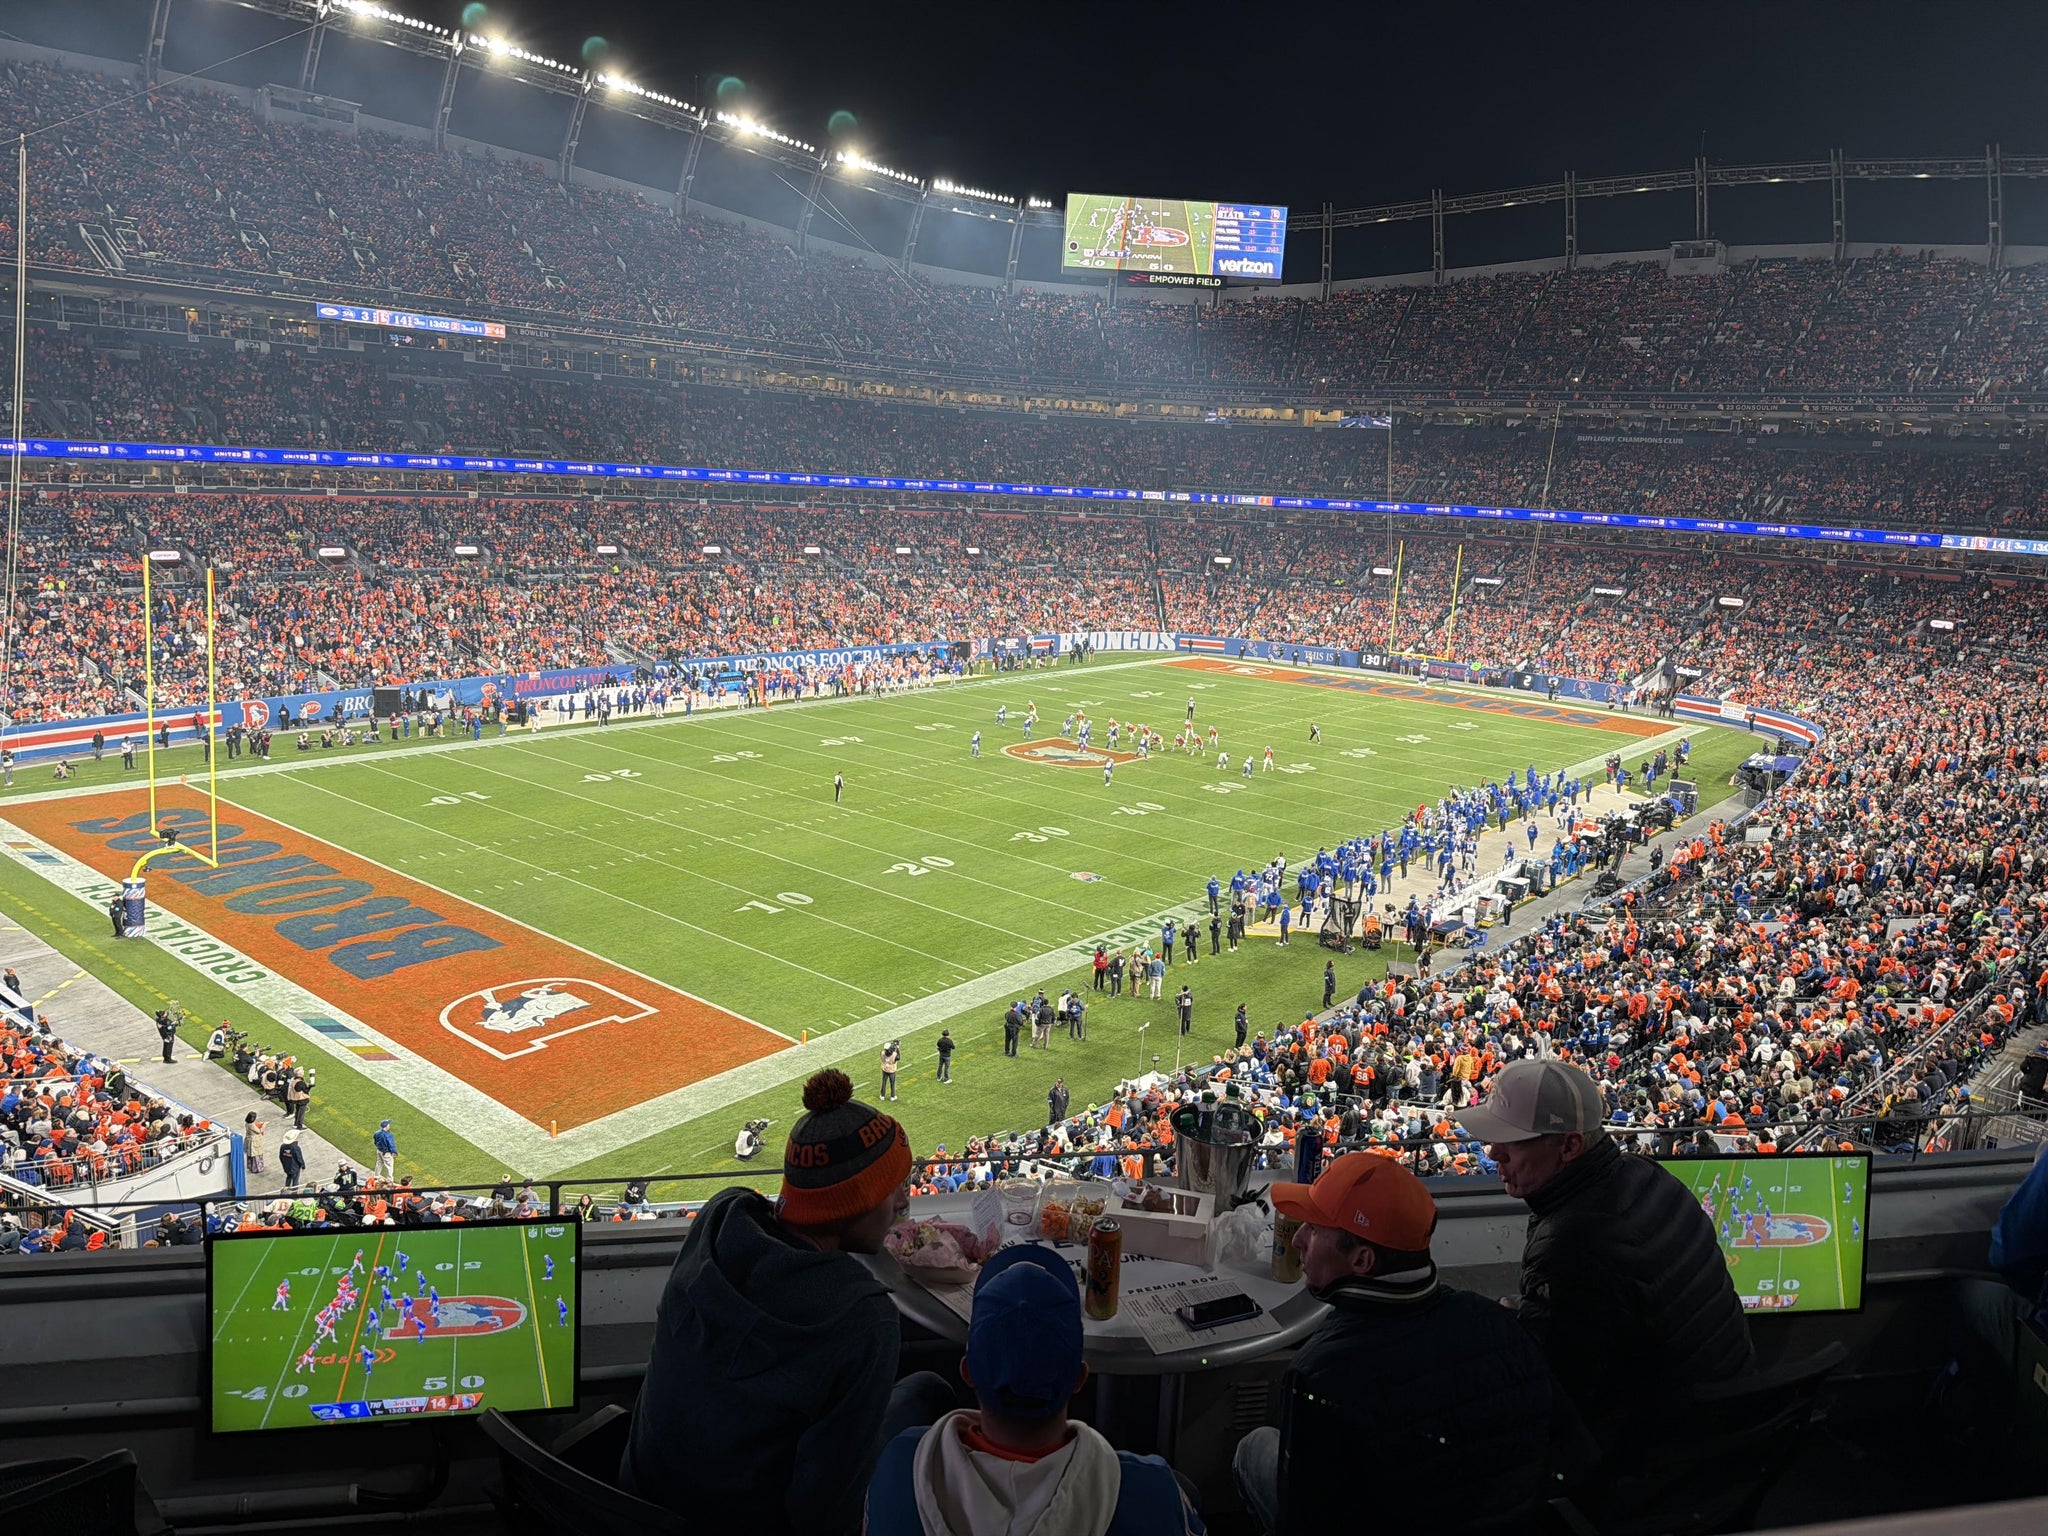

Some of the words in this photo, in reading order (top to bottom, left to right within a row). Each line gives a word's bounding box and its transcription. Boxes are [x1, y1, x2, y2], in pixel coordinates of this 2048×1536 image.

[1218, 258, 1274, 274] verizon
[1149, 275, 1194, 285] EMPOWER
[1196, 277, 1221, 286] FIELD
[361, 311, 369, 321] 3
[394, 315, 407, 325] 14
[429, 320, 449, 329] 13:02
[520, 329, 549, 338] BOWLEN
[620, 341, 644, 349] THOMAS
[1960, 538, 1967, 546] 3
[1992, 540, 2006, 550] 14
[1058, 632, 1176, 650] BRONCOS
[734, 653, 816, 671] BRONCOS
[1326, 652, 1335, 662] IS
[1362, 654, 1387, 667] 13:01
[1298, 675, 1608, 725] BRONCOS
[1202, 781, 1247, 794] 50
[1121, 801, 1166, 816] 40
[1016, 826, 1070, 843] 30
[893, 855, 956, 876] 20
[69, 807, 505, 980] BRONCOS
[745, 891, 814, 915] 10
[149, 921, 268, 984] CRUCIAL
[1356, 1071, 1368, 1081] 58
[545, 1225, 565, 1235] prime
[1127, 1281, 1187, 1295] PREMIUM
[1191, 1276, 1218, 1285] ROW
[1757, 1279, 1800, 1291] 50
[1761, 1297, 1773, 1307] 14
[422, 1375, 486, 1391] 50
[241, 1383, 309, 1400] 40
[350, 1403, 360, 1415] 3
[430, 1397, 447, 1409] 14
